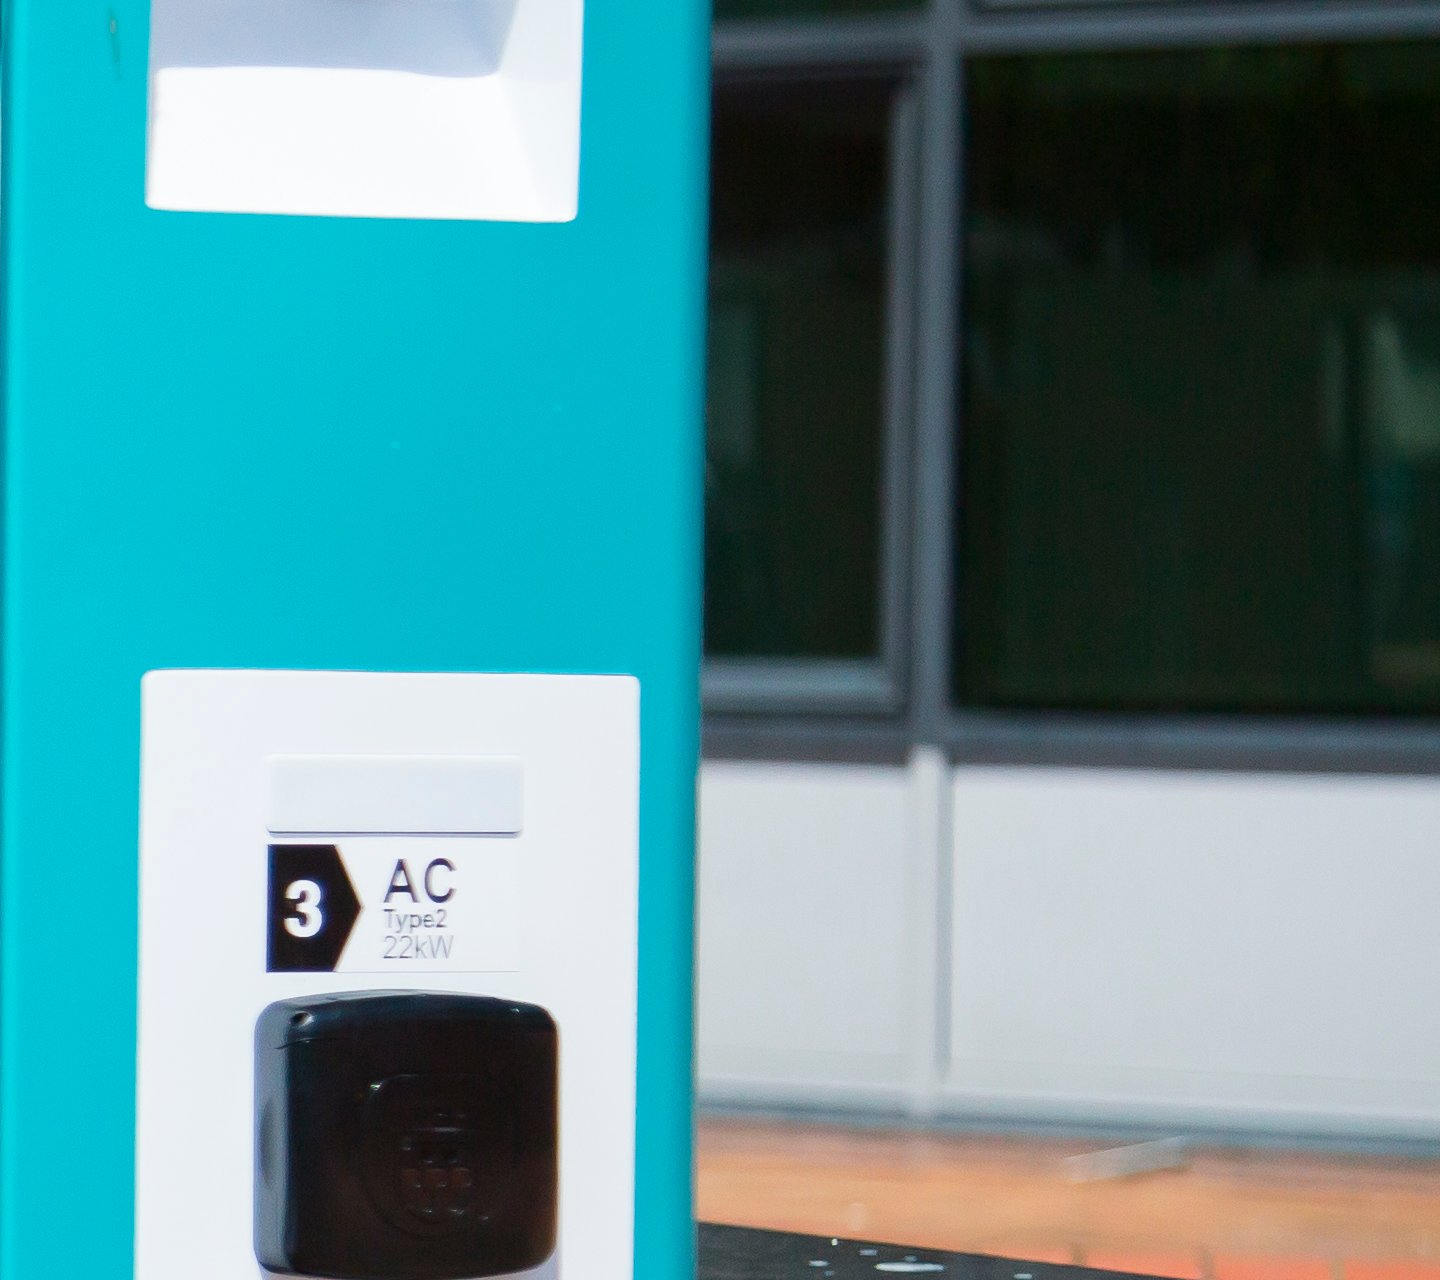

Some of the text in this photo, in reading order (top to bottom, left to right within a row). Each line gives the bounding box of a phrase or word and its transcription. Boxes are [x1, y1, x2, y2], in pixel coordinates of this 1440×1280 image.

[382, 857, 457, 904] AC
[283, 879, 323, 938] 3
[383, 908, 448, 933] Type2
[382, 935, 455, 960] 22kW
